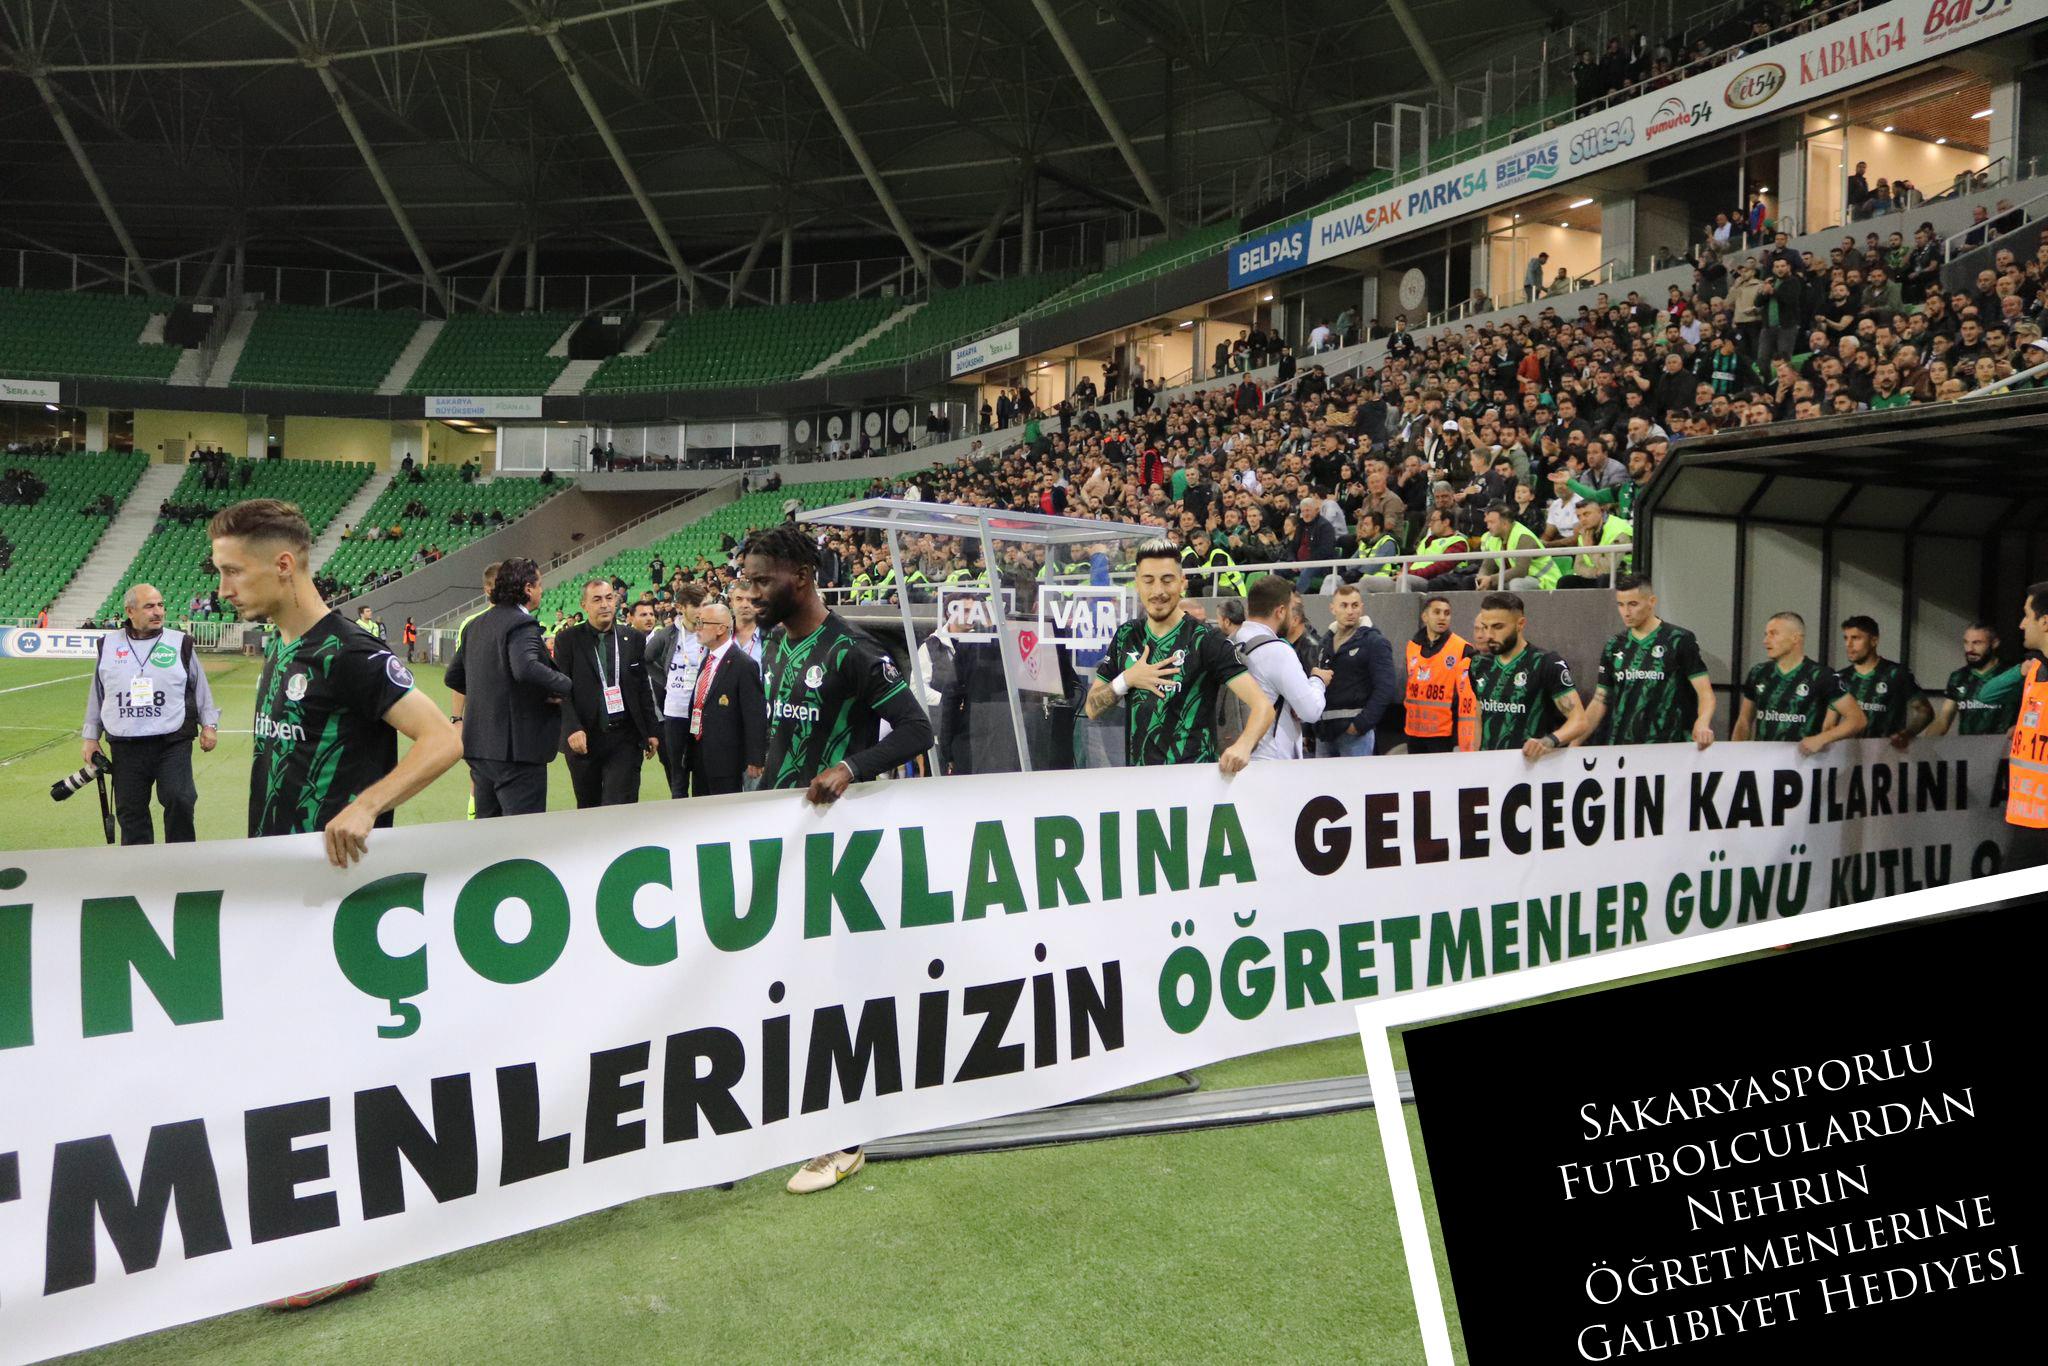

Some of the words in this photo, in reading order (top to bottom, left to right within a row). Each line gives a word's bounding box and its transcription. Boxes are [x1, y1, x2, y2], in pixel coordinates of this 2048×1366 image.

[1800, 17, 1906, 86] KABAK54
[1645, 101, 1712, 141] yumurta54
[1408, 168, 1488, 217] PARK54
[1321, 199, 1403, 246] HAVASAK
[1239, 233, 1303, 276] BELPAŞ
[1050, 600, 1118, 633] VAR
[1426, 684, 1446, 701] 085
[1625, 669, 1665, 681] bitexen
[119, 706, 162, 719] PRESS
[1484, 698, 1526, 714] bitexen
[1765, 709, 1807, 723] bitexen
[2032, 733, 2048, 762] 17
[332, 803, 1257, 1039] ÇOCUKLARINA
[1294, 756, 1665, 877] GELECEĞİN
[1688, 759, 1969, 833] KAPILARINI
[1158, 880, 1648, 1035] ÖĞRETMENLER
[1665, 843, 1812, 935] GÜNÜ
[1829, 843, 1952, 909] KUTLU
